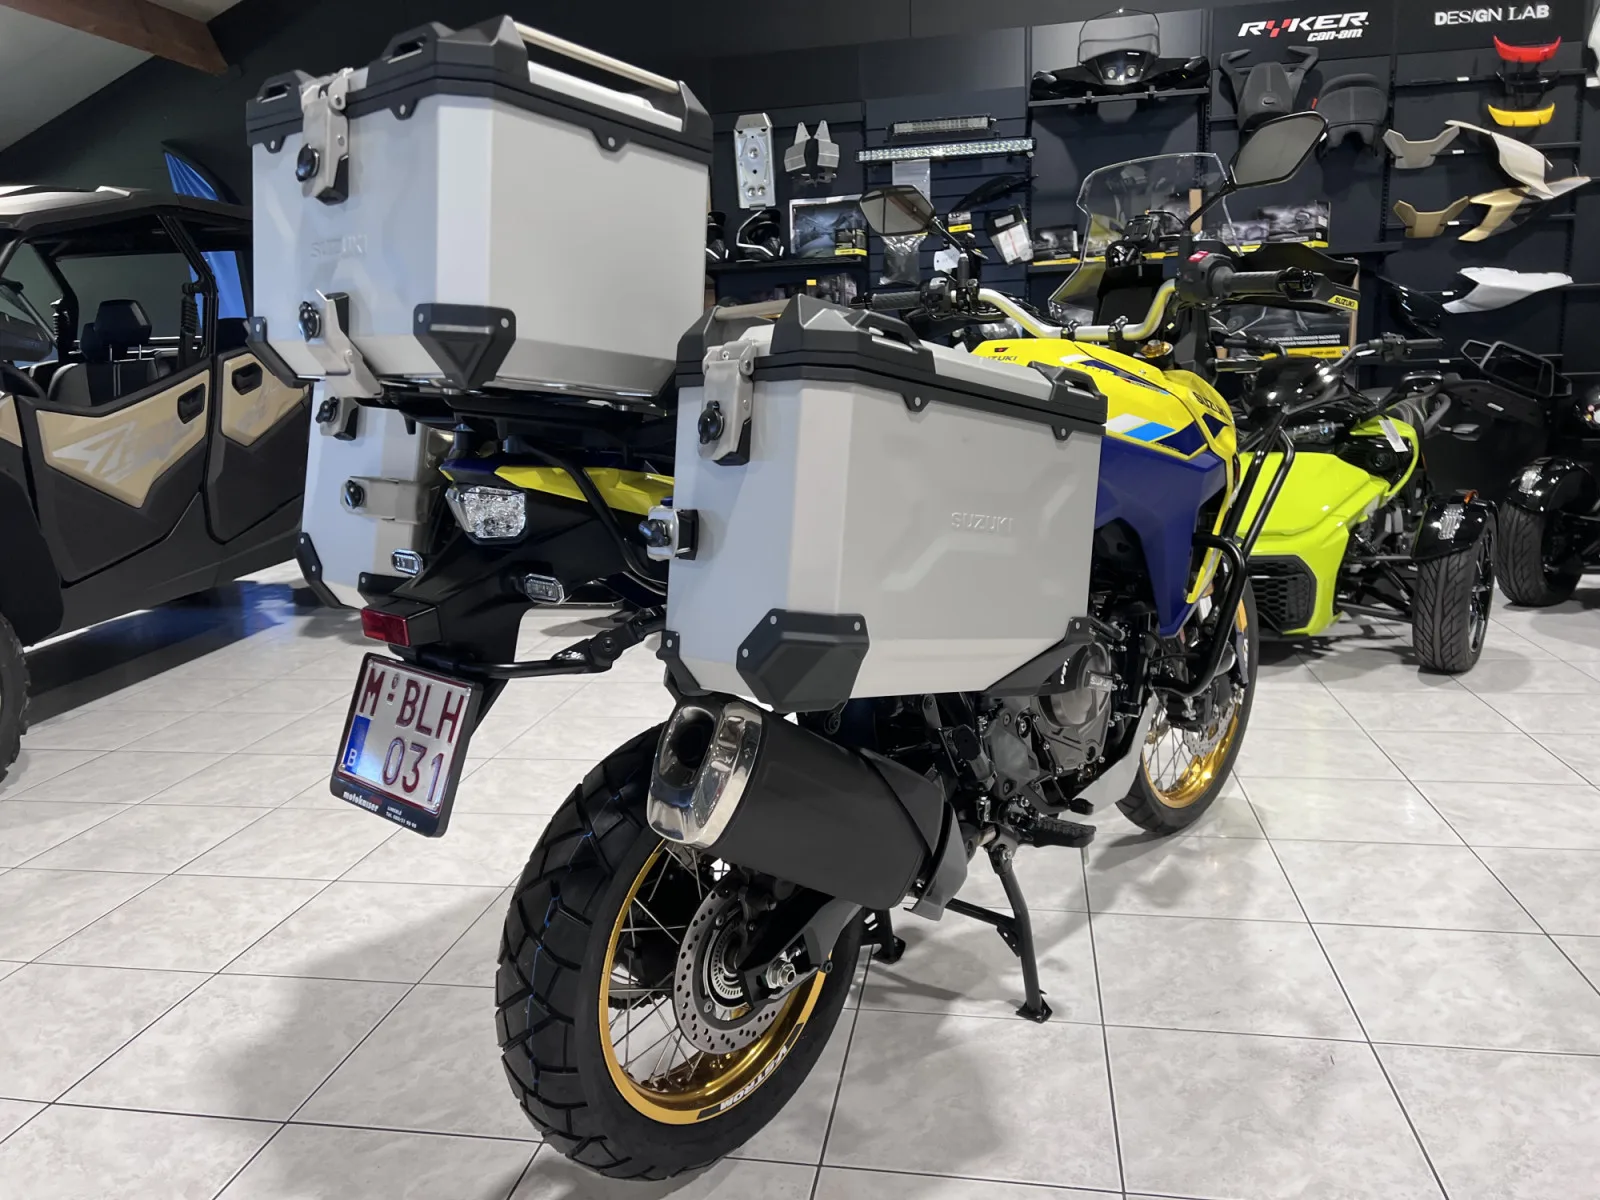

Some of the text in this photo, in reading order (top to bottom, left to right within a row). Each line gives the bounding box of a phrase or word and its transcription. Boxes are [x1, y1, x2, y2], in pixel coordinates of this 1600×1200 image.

[1434, 4, 1550, 26] DESIGN LAB
[1307, 28, 1363, 42] can-am
[310, 234, 368, 258] SUZUKI
[1335, 296, 1356, 308] SUZUKI
[951, 511, 1016, 533] SUZUKI
[382, 736, 445, 803] 031
